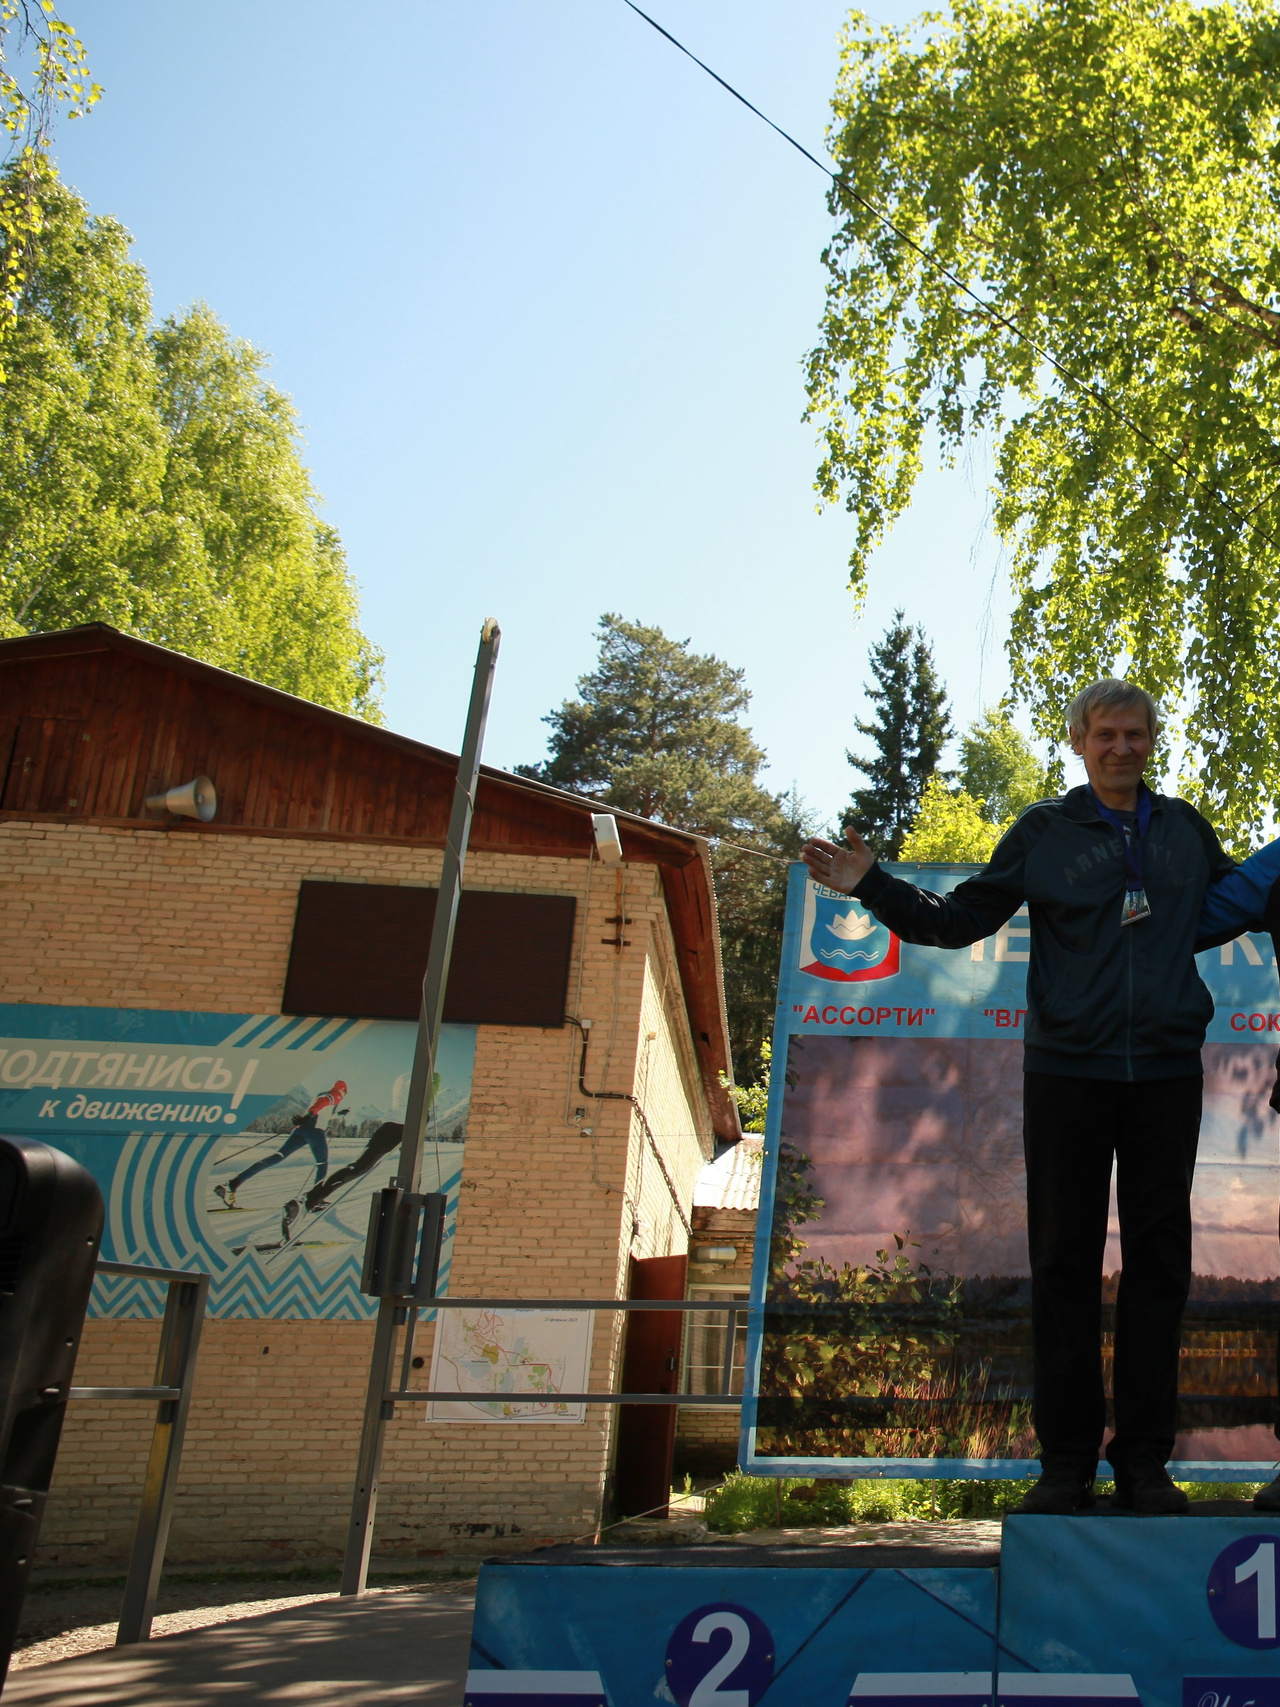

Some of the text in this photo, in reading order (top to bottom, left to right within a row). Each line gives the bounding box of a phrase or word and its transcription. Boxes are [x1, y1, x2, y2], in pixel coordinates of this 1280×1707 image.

[792, 1005, 936, 1027] "АССОРТИ"
[66, 1093, 223, 1124] движению
[1234, 1542, 1277, 1640] 1
[691, 1611, 751, 1707] 2
